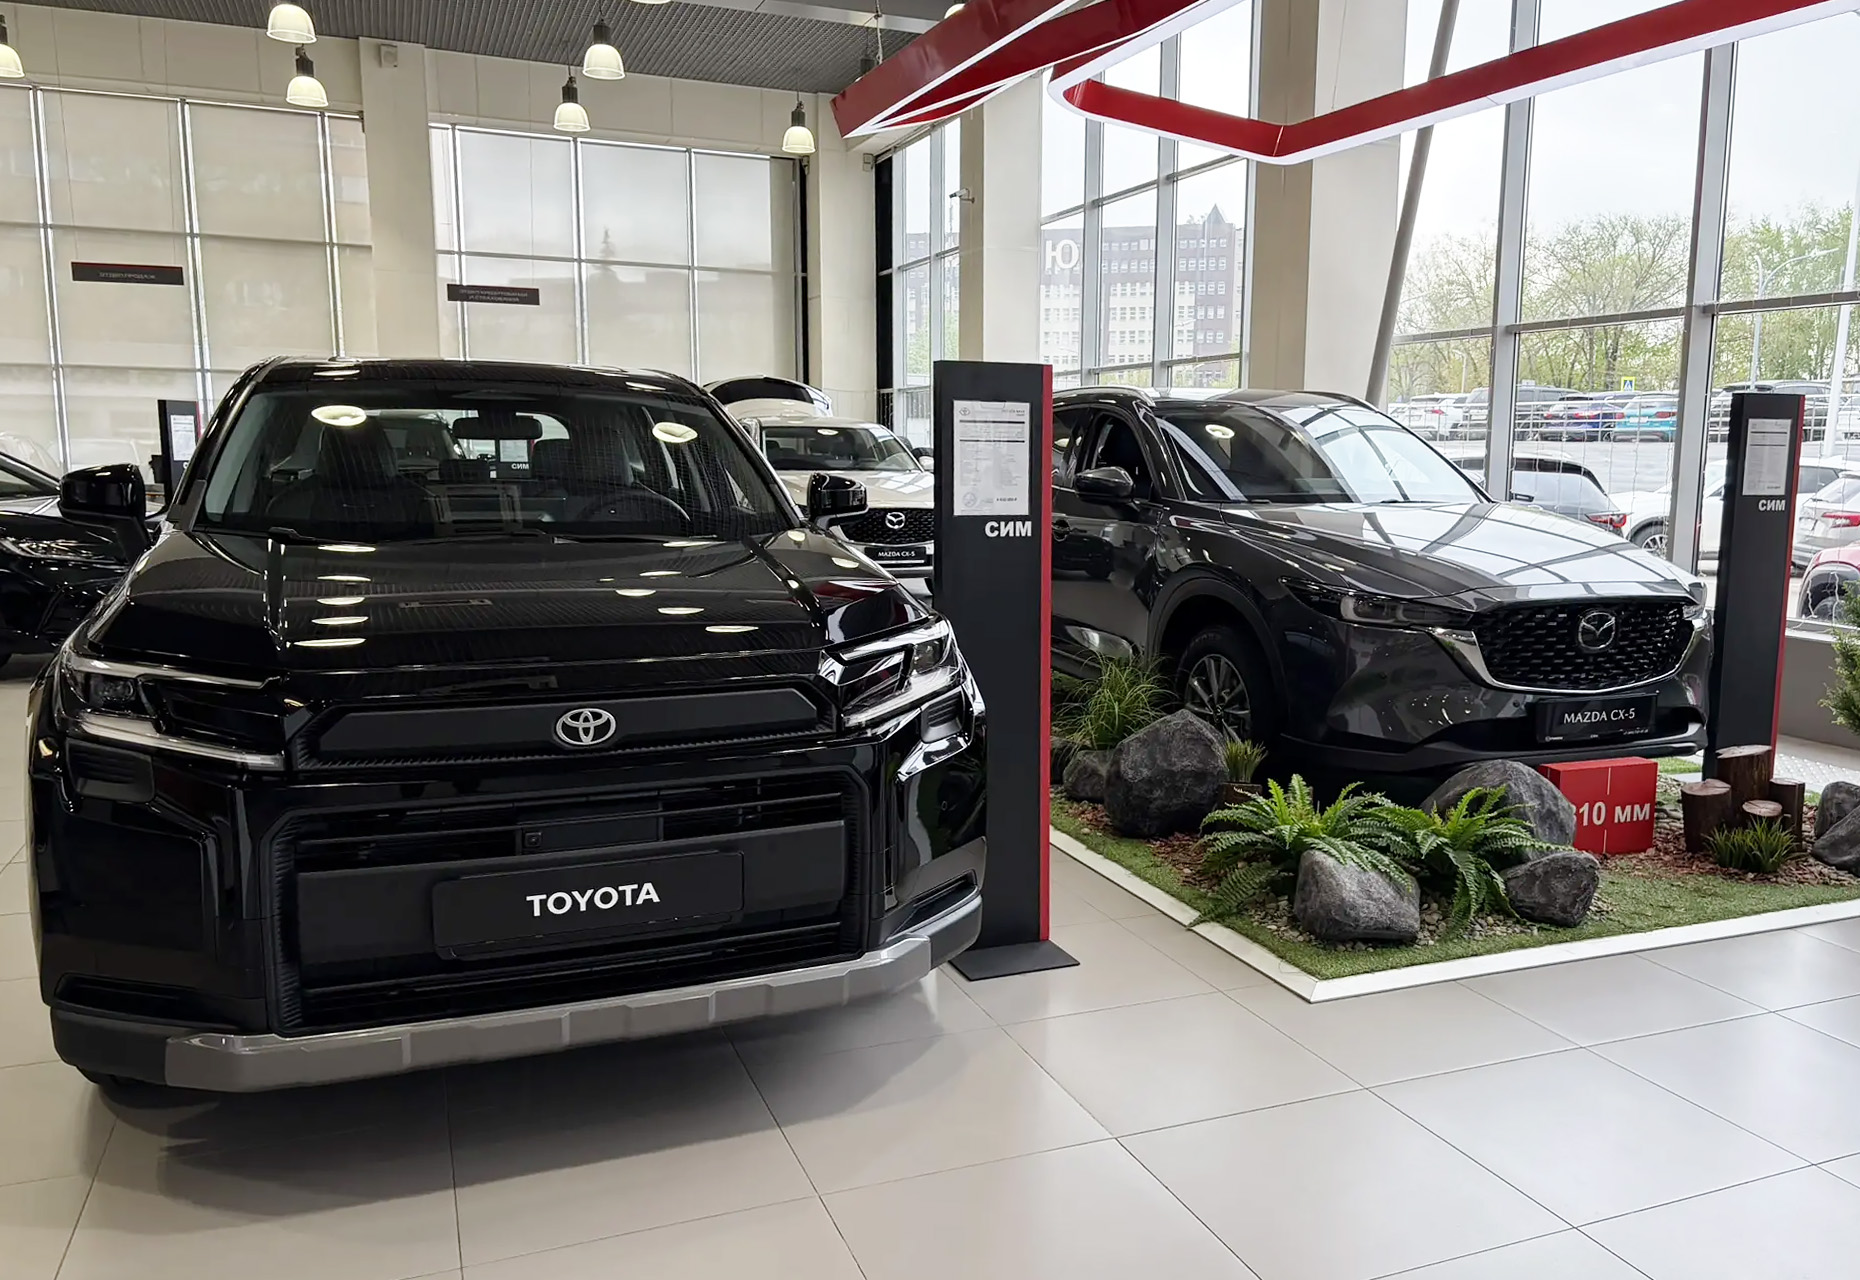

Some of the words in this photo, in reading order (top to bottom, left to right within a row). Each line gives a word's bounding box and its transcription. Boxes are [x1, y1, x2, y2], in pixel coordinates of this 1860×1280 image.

[1045, 239, 1079, 269] Ю
[1758, 499, 1786, 511] СИМ
[985, 521, 1032, 537] СИМ
[1563, 710, 1607, 724] MAZDA
[1610, 707, 1635, 721] CX-5
[1571, 802, 1606, 826] 10
[526, 882, 661, 917] TOYOTA
